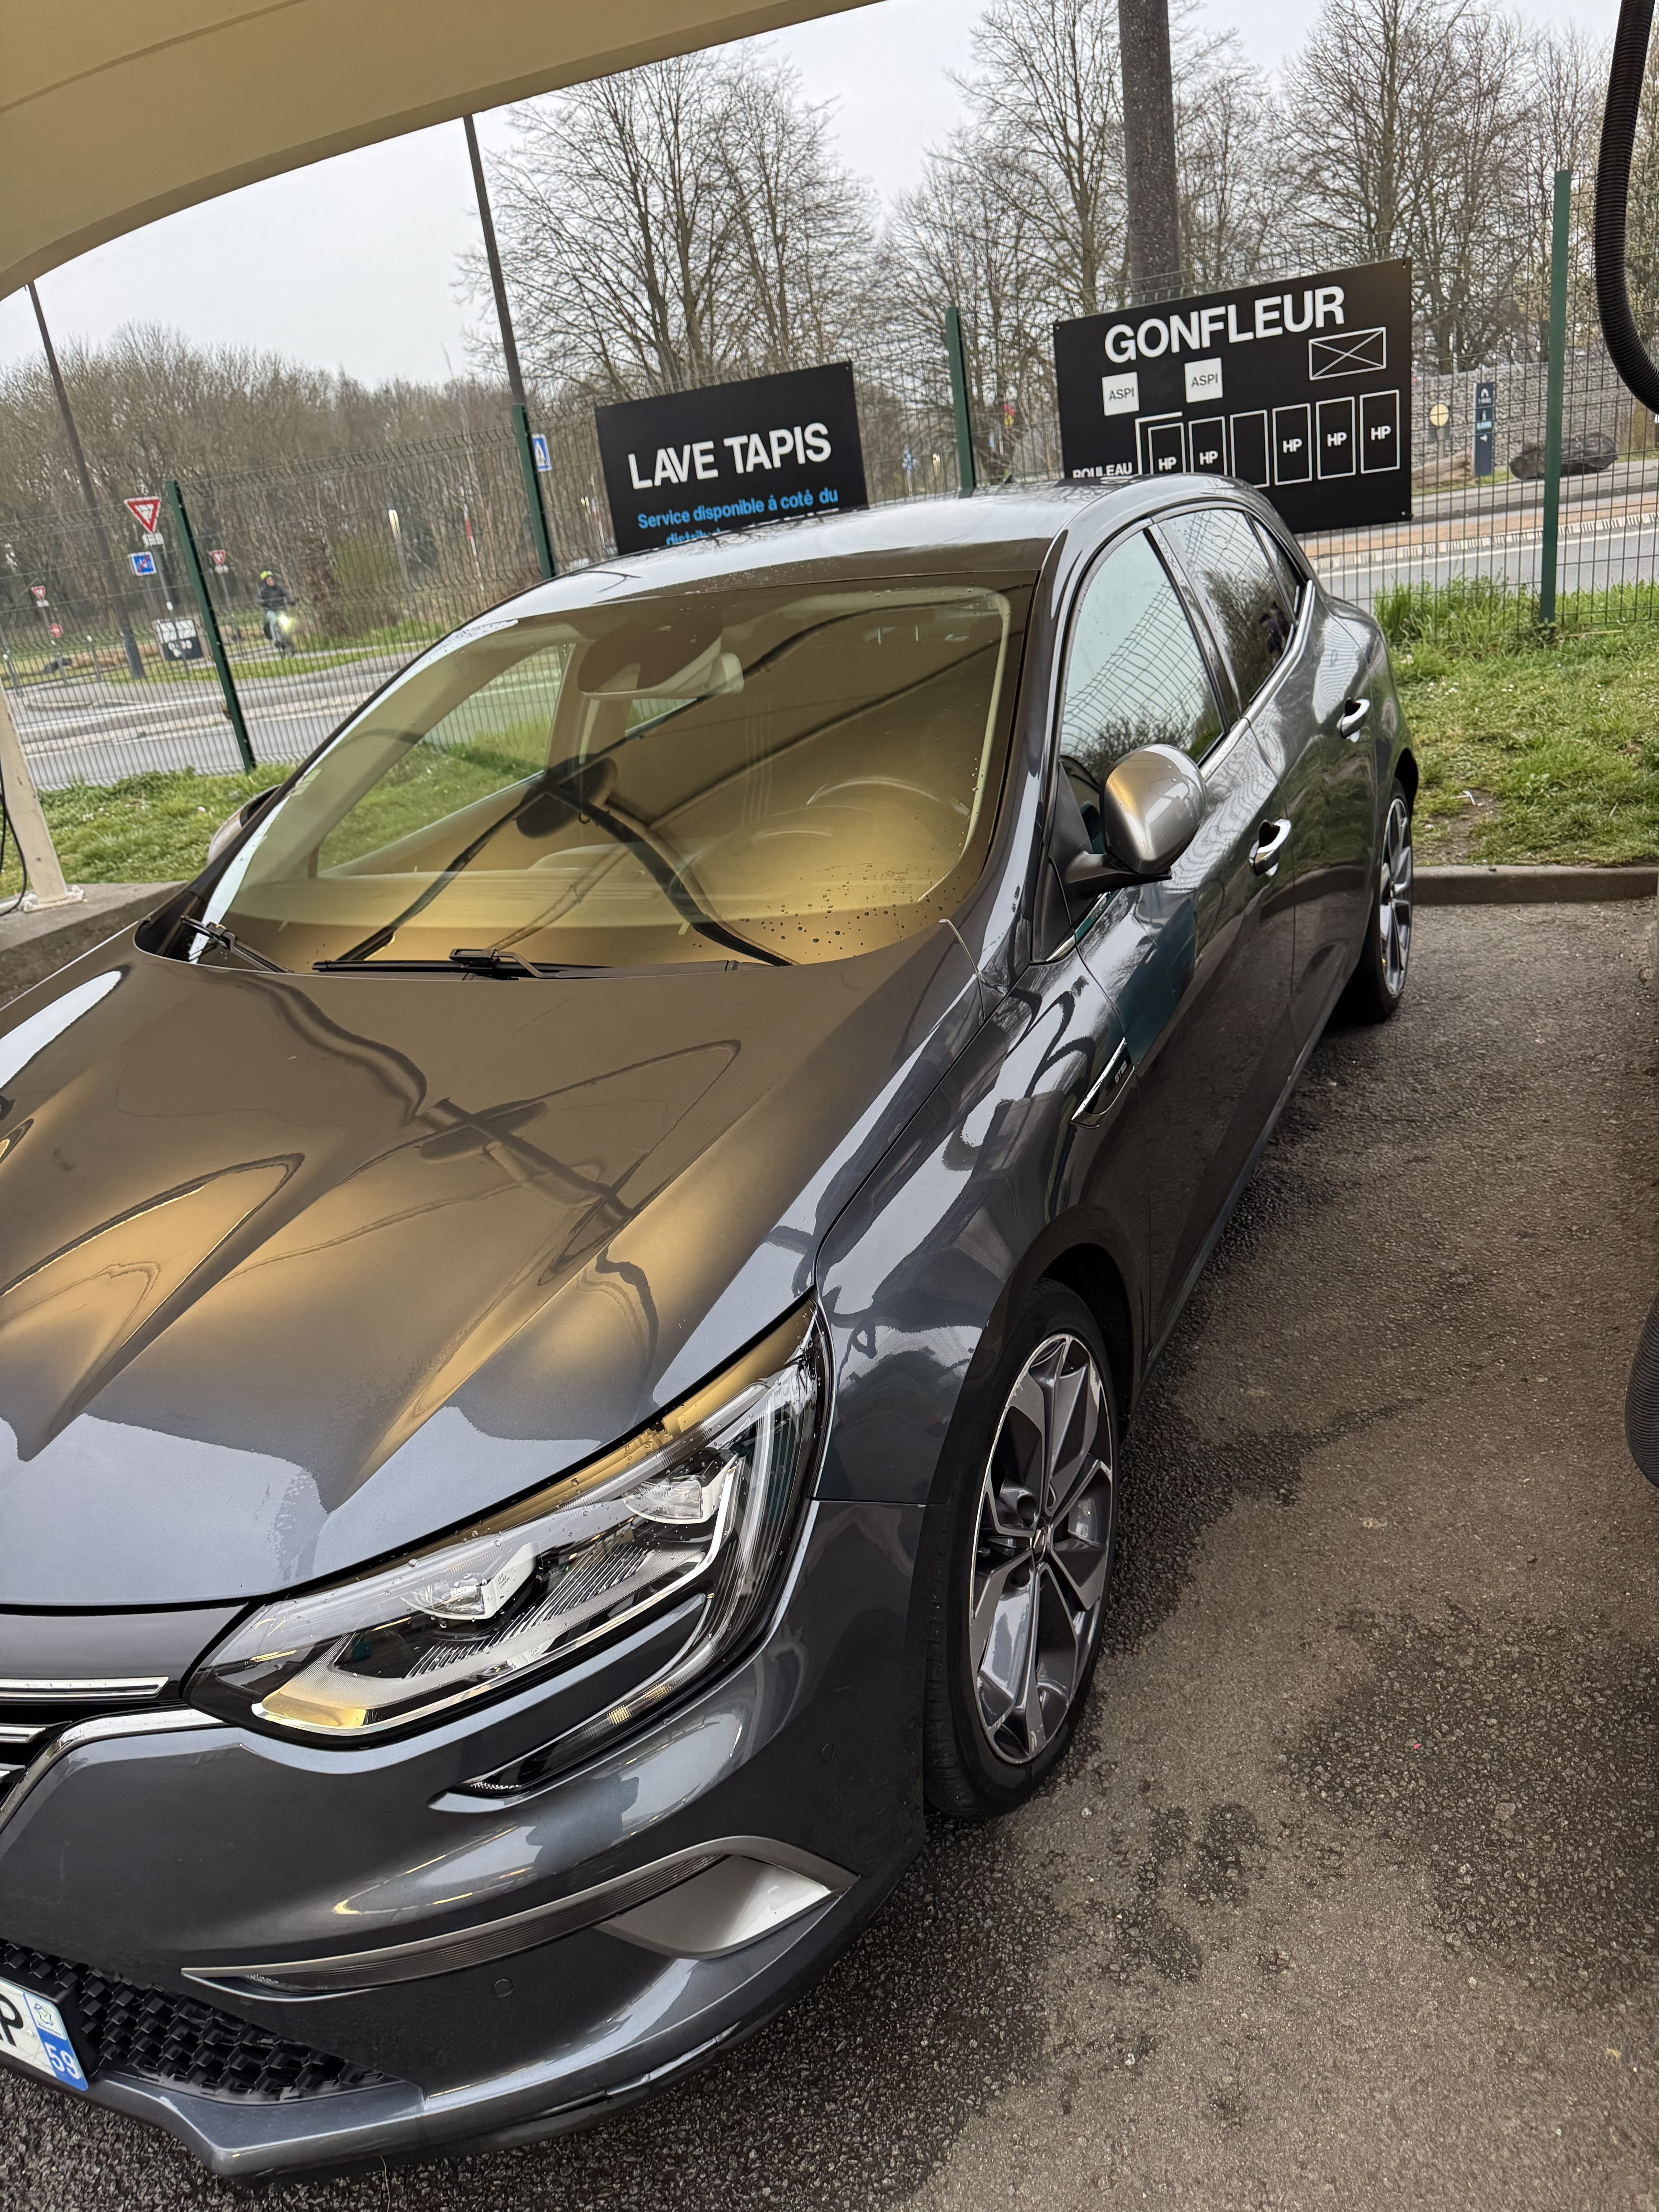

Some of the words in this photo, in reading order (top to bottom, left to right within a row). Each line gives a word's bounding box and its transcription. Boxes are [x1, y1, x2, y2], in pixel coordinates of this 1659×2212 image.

[1105, 286, 1345, 363] GONFLEUR
[1191, 373, 1219, 388] ASPI
[1109, 387, 1135, 401] ASPI
[1327, 432, 1347, 447] HP
[1371, 425, 1391, 441] HP
[1283, 438, 1302, 453] HP
[628, 441, 719, 489] LAVE
[723, 422, 831, 474] TAPIS
[1199, 450, 1218, 465] HP
[1158, 456, 1177, 471] HP
[637, 509, 690, 529] Service
[693, 497, 765, 522] disponible
[780, 489, 814, 510] coté
[819, 487, 839, 504] du
[0, 1994, 24, 2047] P
[44, 2042, 80, 2080] 59
